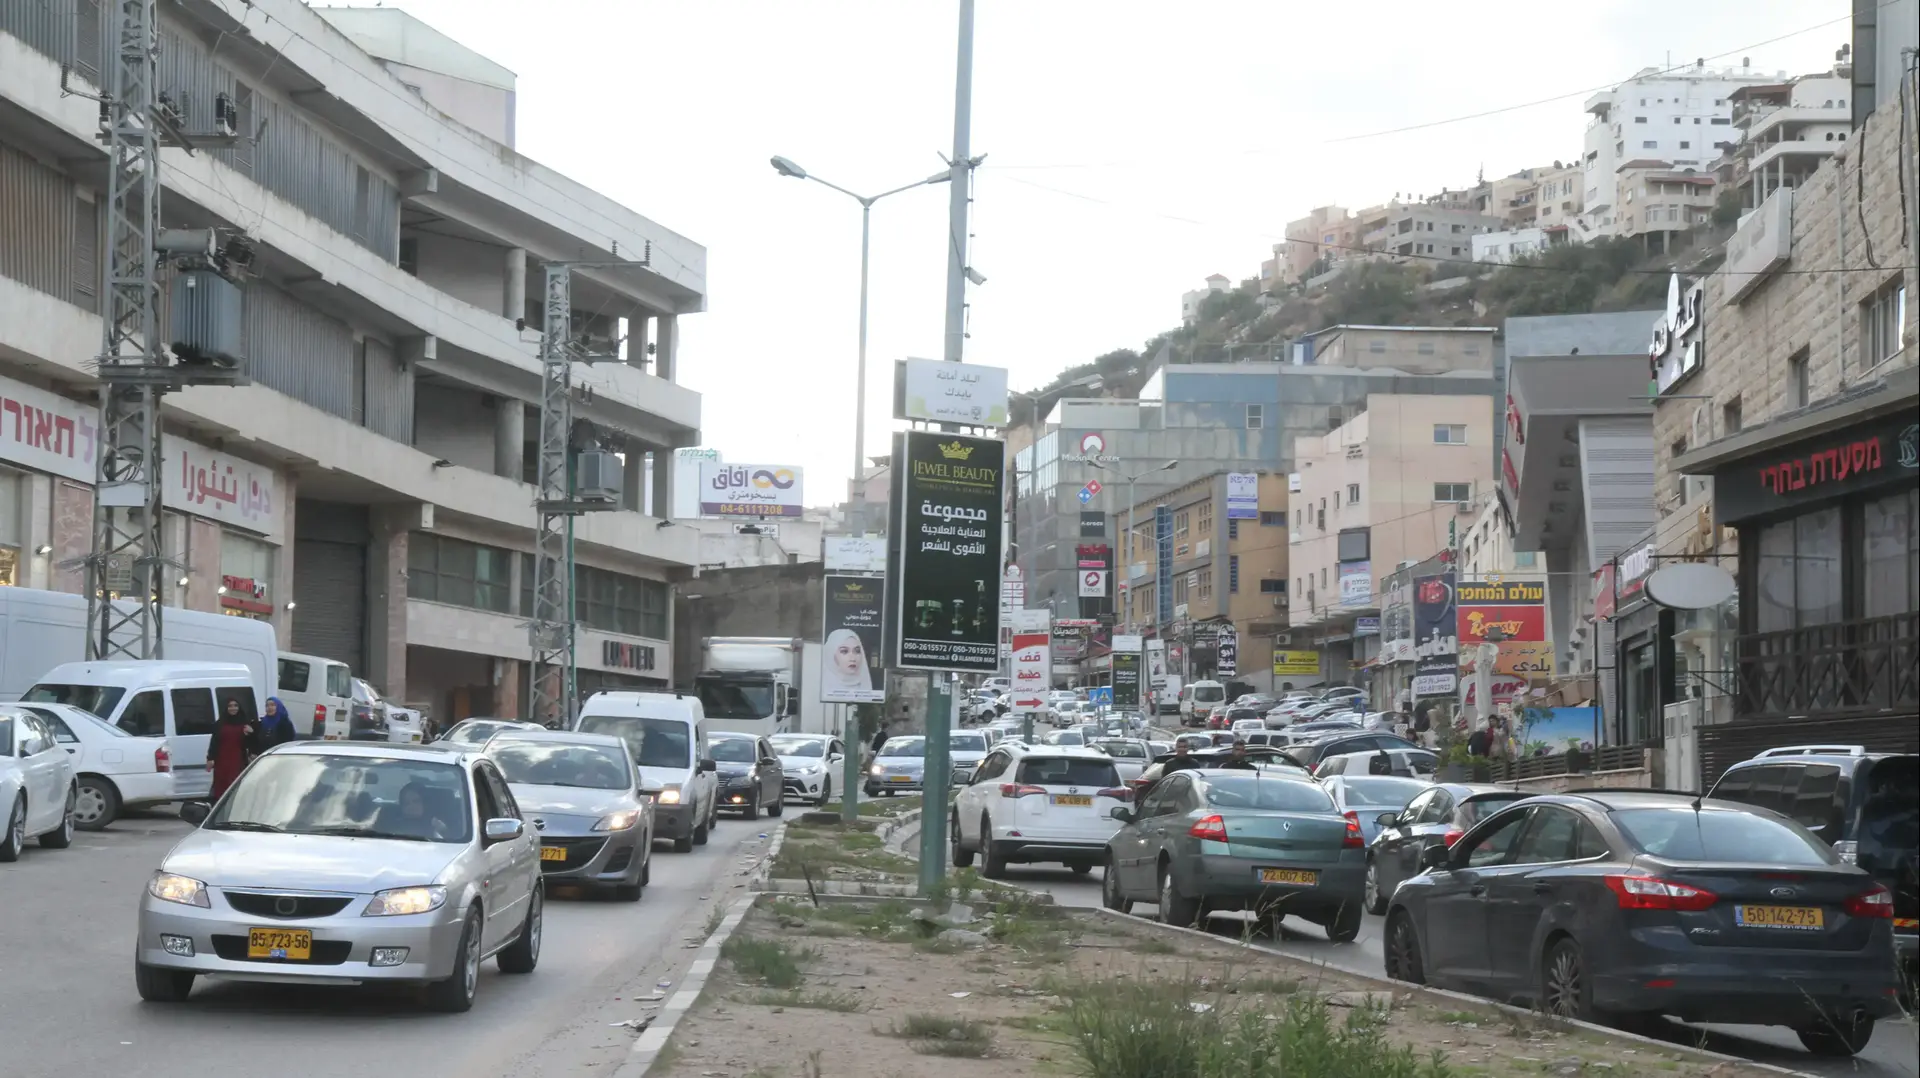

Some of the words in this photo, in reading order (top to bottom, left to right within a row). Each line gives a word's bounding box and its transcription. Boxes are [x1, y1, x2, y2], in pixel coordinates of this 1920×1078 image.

[0, 396, 75, 458] תאור
[913, 460, 951, 477] JEWEL
[953, 465, 999, 483] BEAUTY
[920, 499, 987, 524] مجموعة
[921, 523, 956, 537] العلاجية
[957, 526, 986, 539] العناية
[920, 538, 951, 553] للشعر
[952, 540, 986, 556] الأقوى
[1508, 582, 1544, 600] עולם
[903, 642, 947, 652] 050-2615572
[953, 645, 996, 655] 050-7615573
